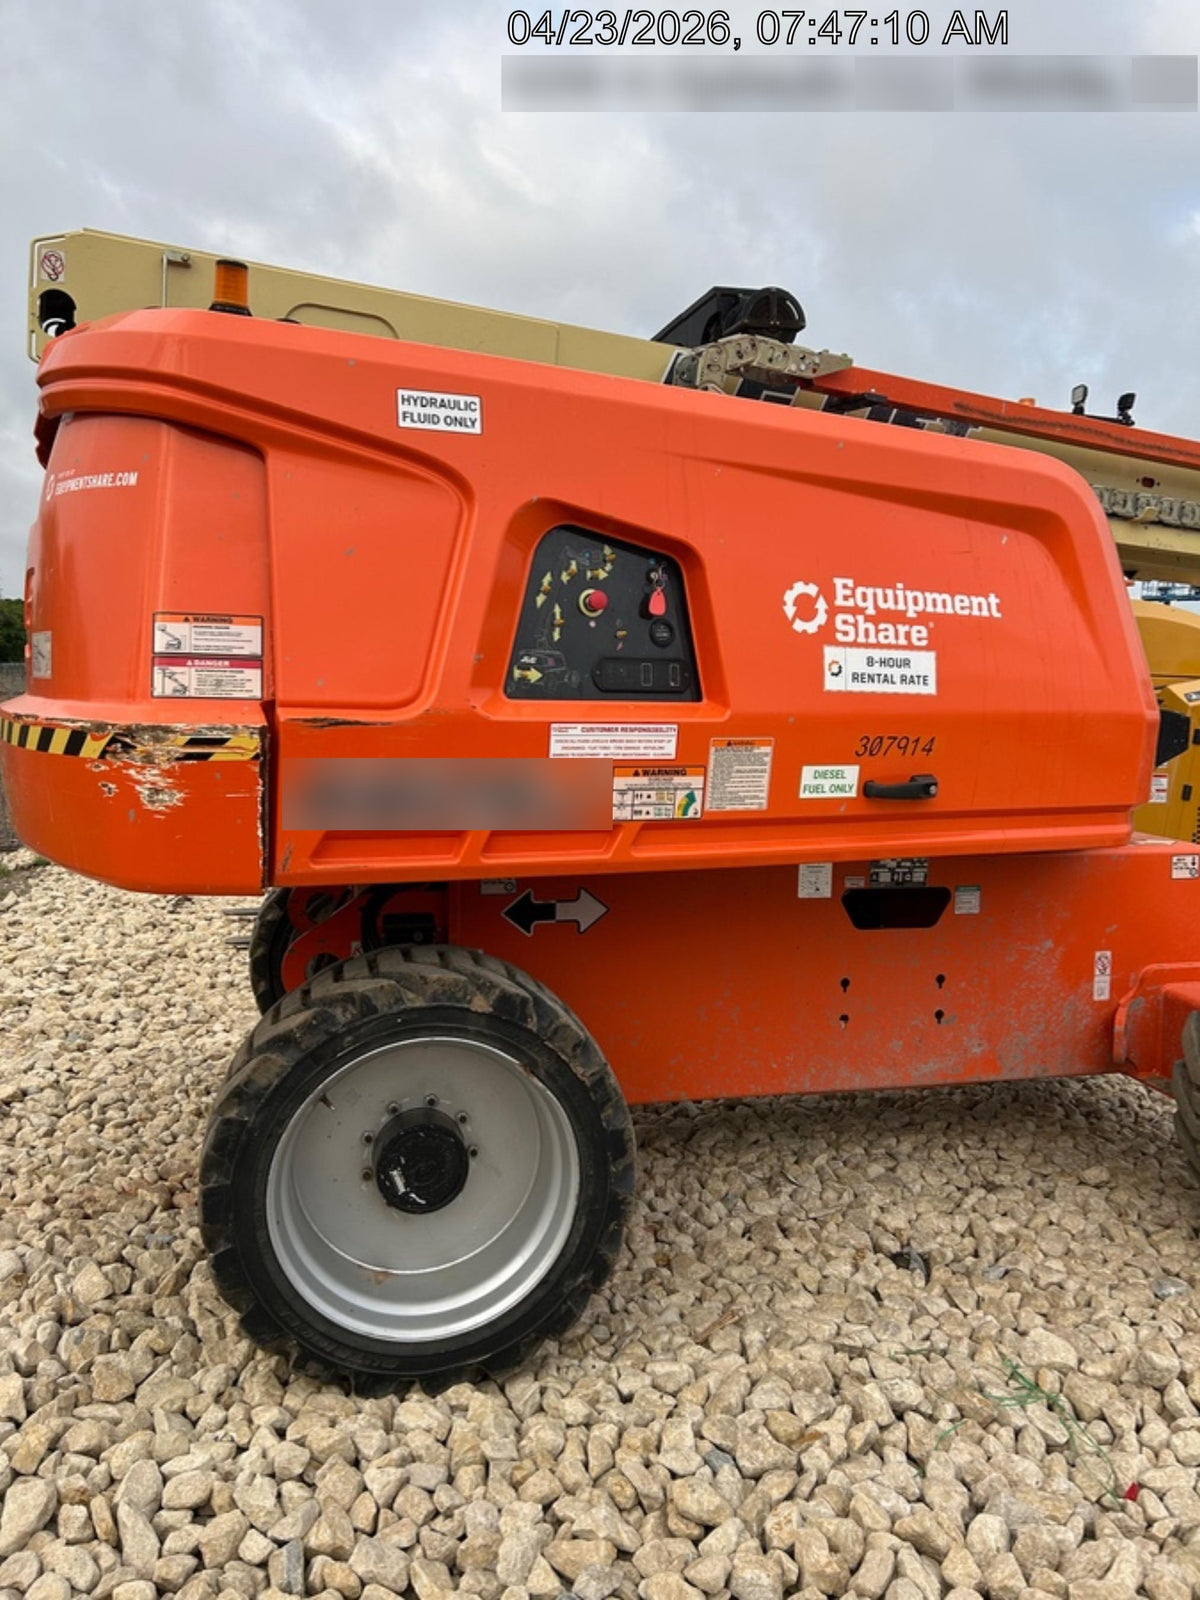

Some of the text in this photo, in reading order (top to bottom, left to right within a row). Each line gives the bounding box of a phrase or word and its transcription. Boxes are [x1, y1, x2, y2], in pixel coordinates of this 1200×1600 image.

[401, 394, 477, 412] HYDRAULIC
[402, 411, 477, 428] FLUID ONLY
[833, 577, 1002, 618] Equipment
[835, 613, 928, 646] Share
[866, 656, 911, 669] 8-HOUR
[851, 672, 929, 686] RENTAL RATE
[855, 735, 936, 757] 307914
[642, 768, 687, 777] WARNING
[813, 769, 847, 780] DIESEL
[803, 783, 854, 794] FUEL ONLY
